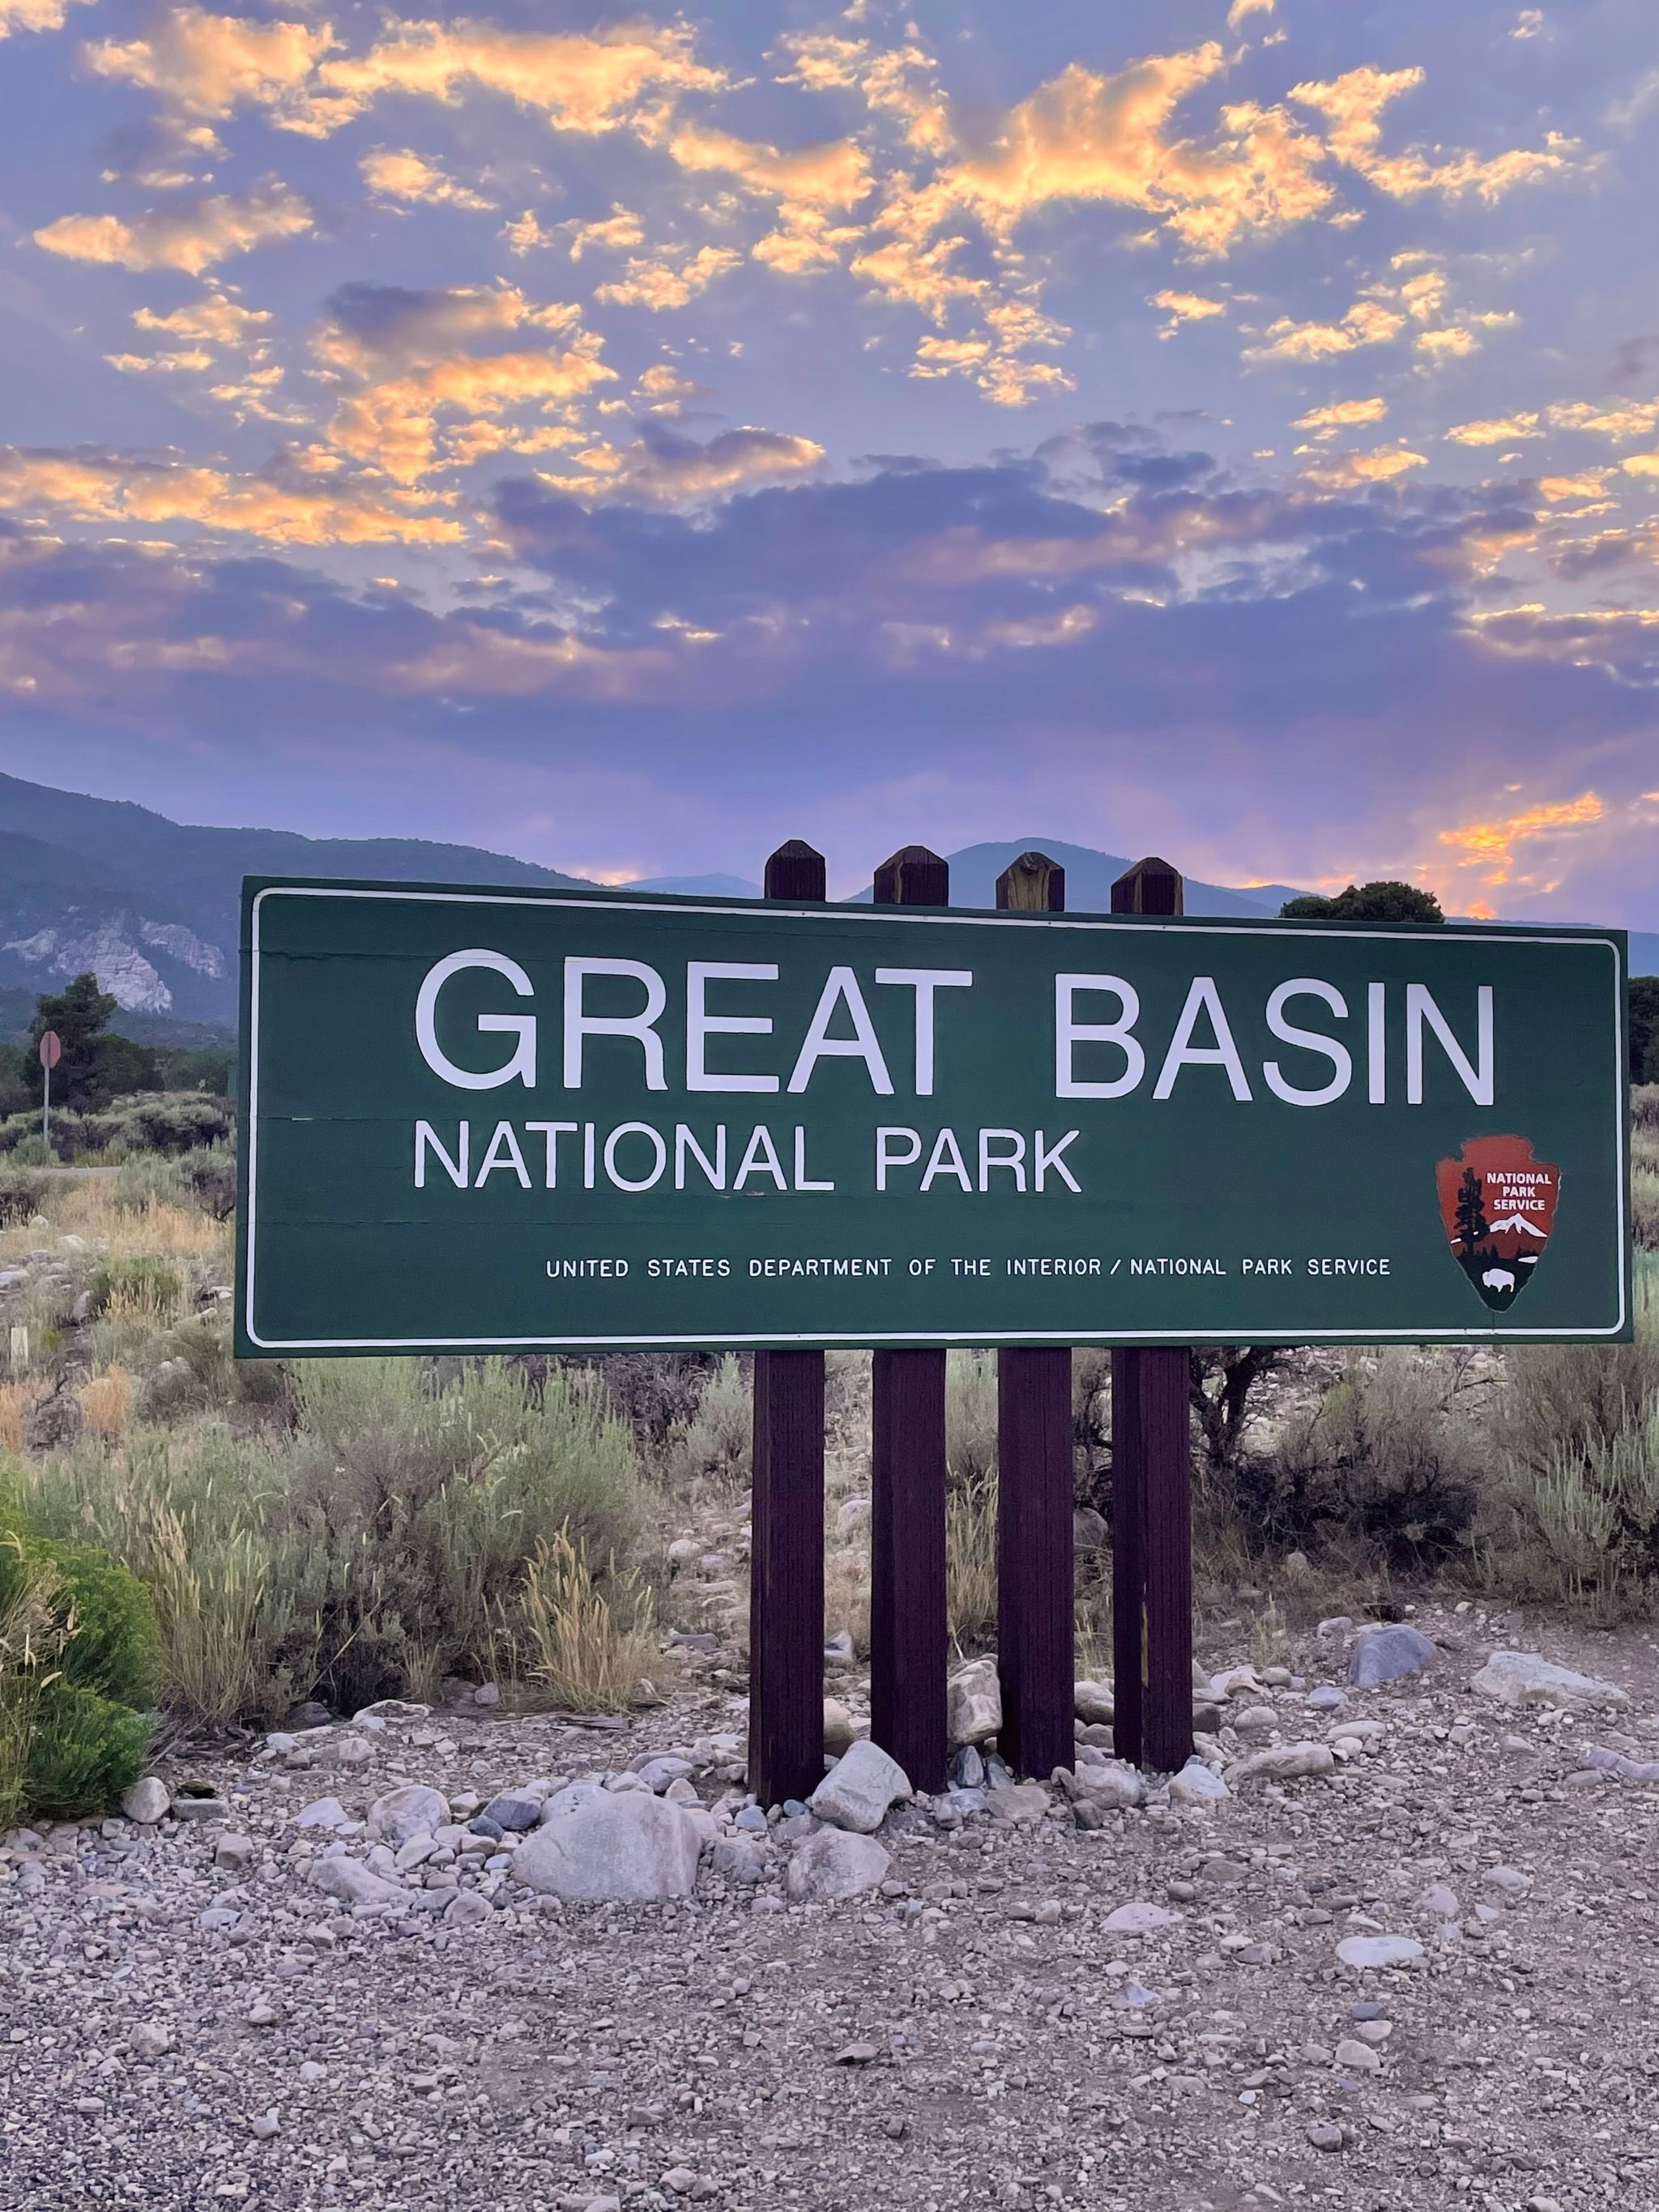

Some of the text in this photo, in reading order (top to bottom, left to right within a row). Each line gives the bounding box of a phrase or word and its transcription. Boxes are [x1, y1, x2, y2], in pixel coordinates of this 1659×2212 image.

[414, 948, 1495, 1107] GREAT BASIN
[413, 1119, 1083, 1194] NATIONAL PARK
[1486, 1172, 1553, 1185] NATIONAL
[1502, 1185, 1537, 1198] PARK
[1493, 1198, 1546, 1212] SERVICE
[546, 1259, 629, 1278] UNITED
[646, 1258, 731, 1277] STATES
[748, 1258, 893, 1277] DEPARTMENT
[908, 1258, 936, 1276] OF
[950, 1258, 992, 1277] THE
[1006, 1258, 1102, 1276] INTERIOR
[1130, 1258, 1227, 1276] NATIONAL
[1242, 1258, 1293, 1276] PARK
[1307, 1258, 1391, 1276] SERVICE
